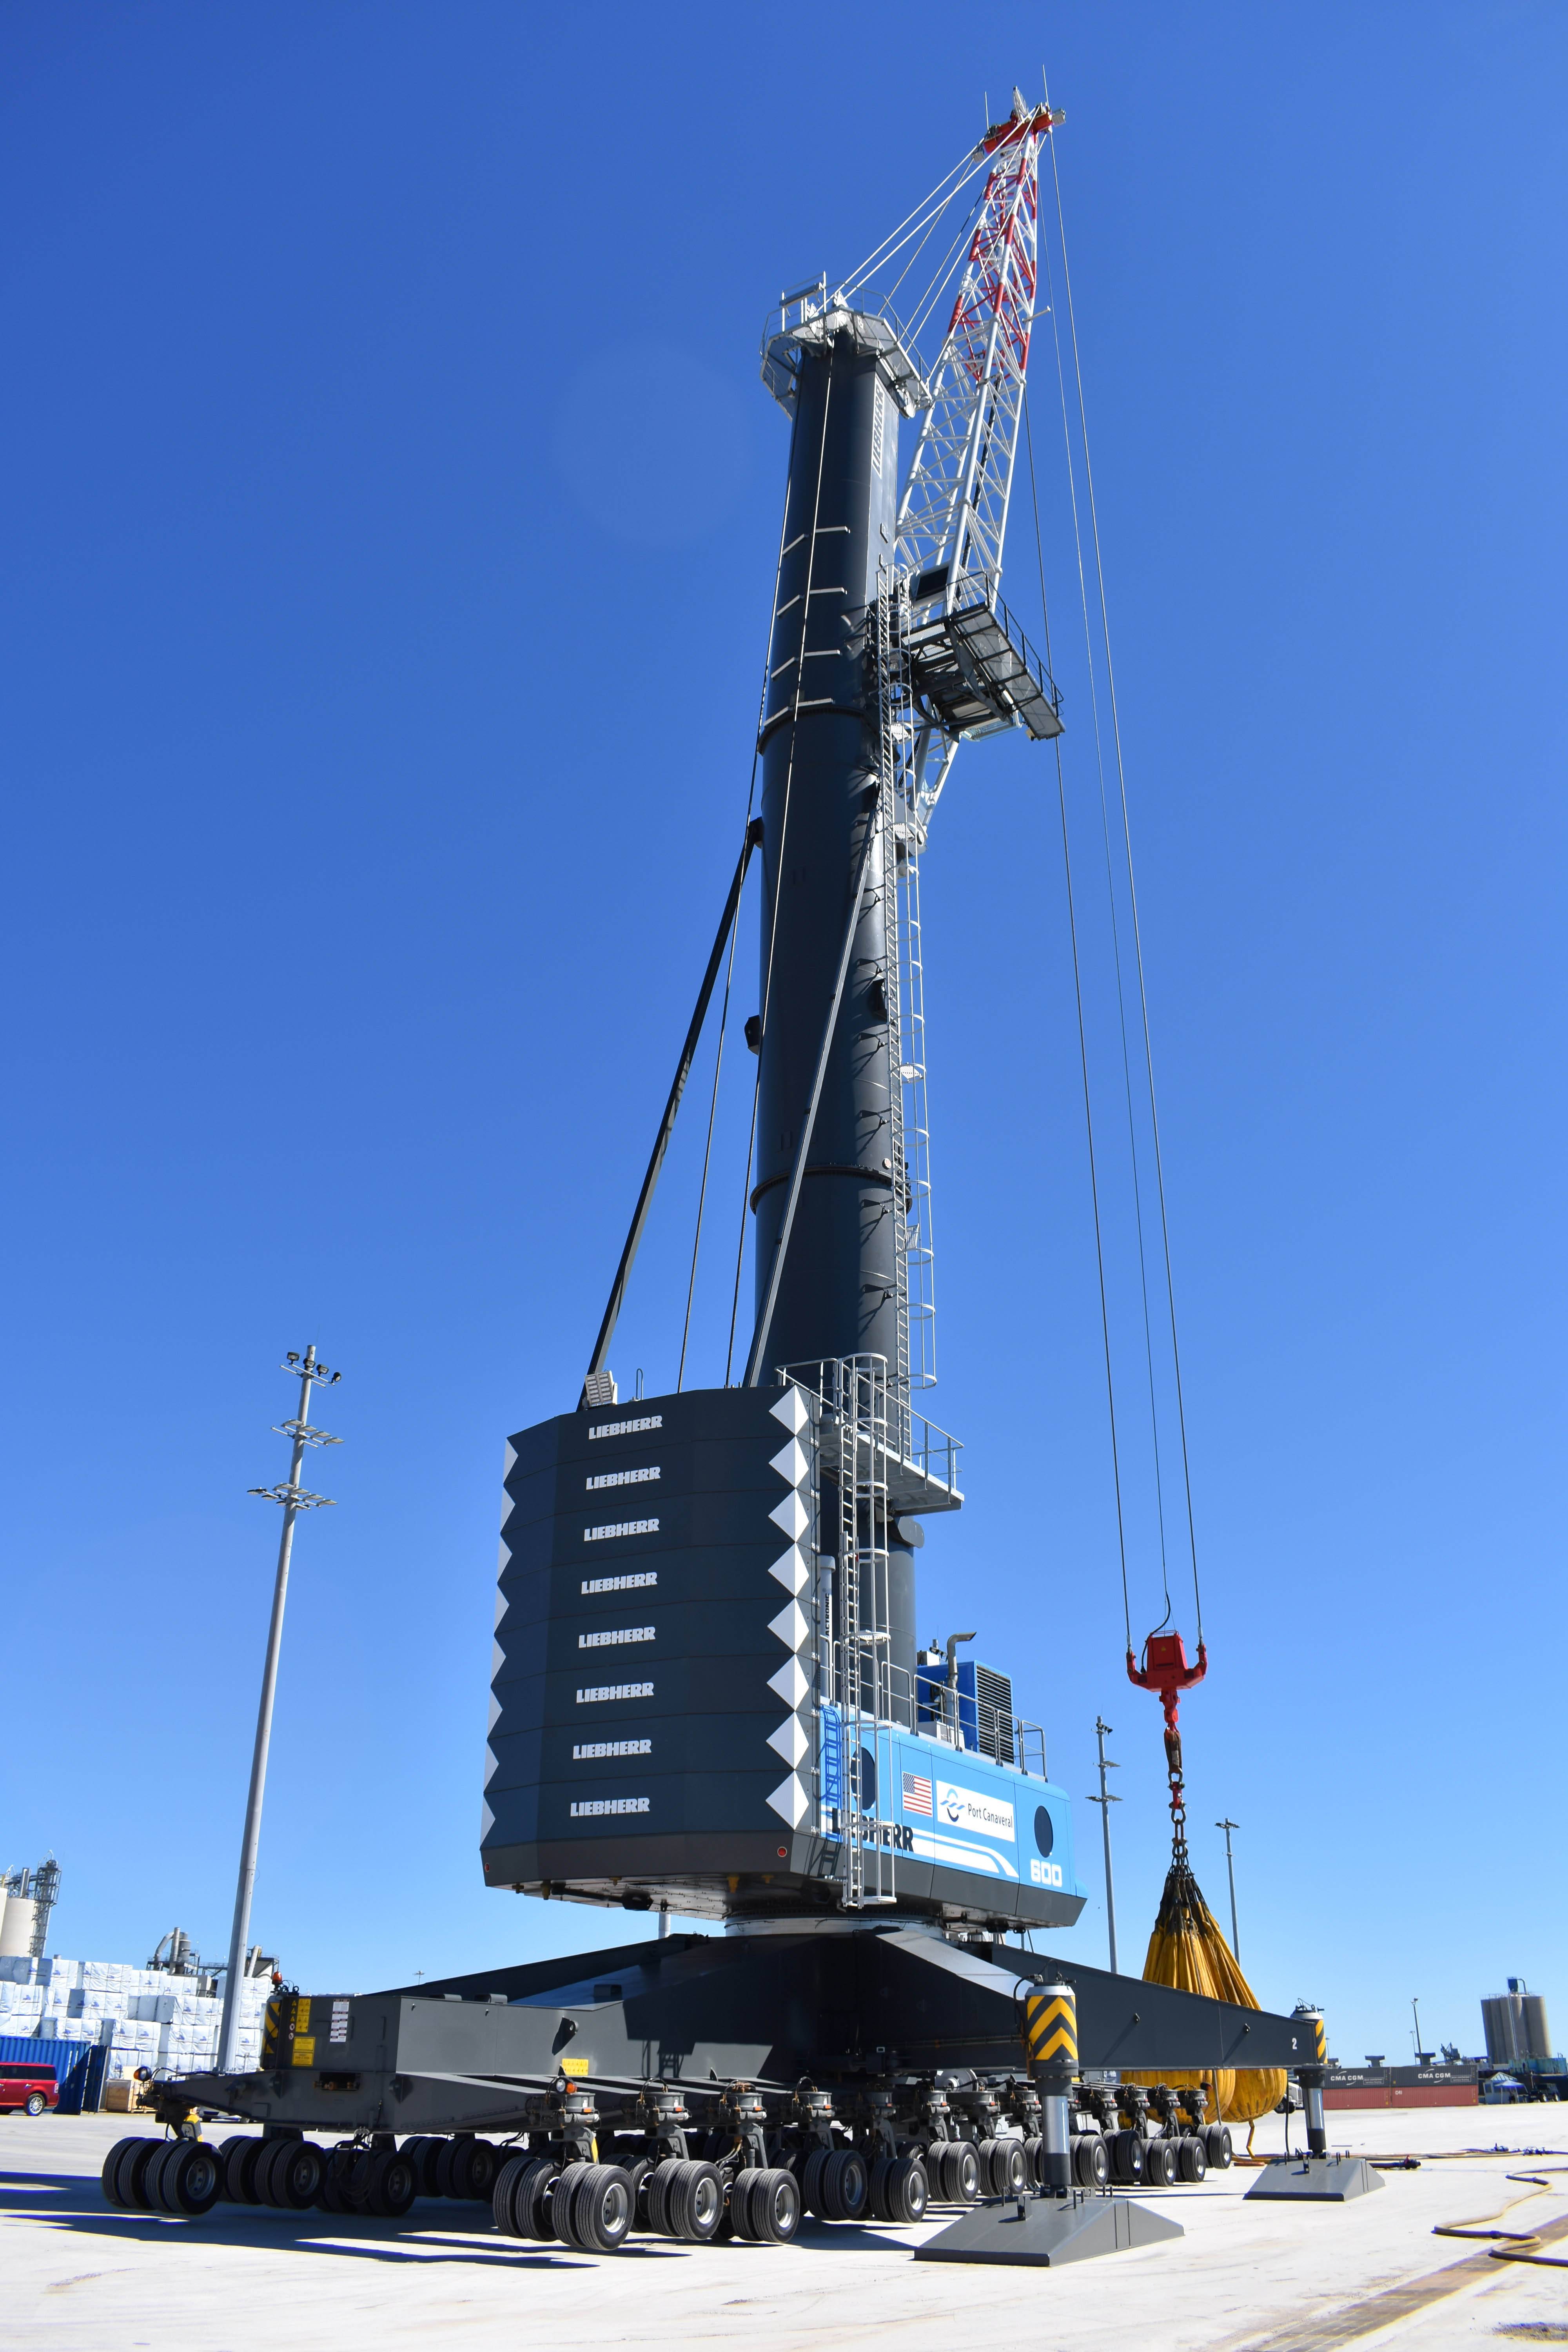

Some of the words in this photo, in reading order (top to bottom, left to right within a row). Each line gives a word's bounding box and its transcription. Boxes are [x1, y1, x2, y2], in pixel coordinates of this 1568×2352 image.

[872, 383, 884, 475] LIEBHERR
[589, 1416, 662, 1439] LIEBHERR
[586, 1466, 661, 1490] LIEBHERR
[584, 1518, 659, 1541] LIEBHERR
[581, 1572, 657, 1594] LIEBHERR
[579, 1626, 656, 1648] LIEBHERR
[576, 1682, 654, 1703] LIEBHERR
[573, 1739, 652, 1759] LIEBHERR
[570, 1798, 650, 1817] LIEBHERR
[968, 1803, 982, 1819] Port
[983, 1808, 1013, 1828] Canaveral
[1031, 1858, 1062, 1887] 600
[1292, 2038, 1297, 2049] 2
